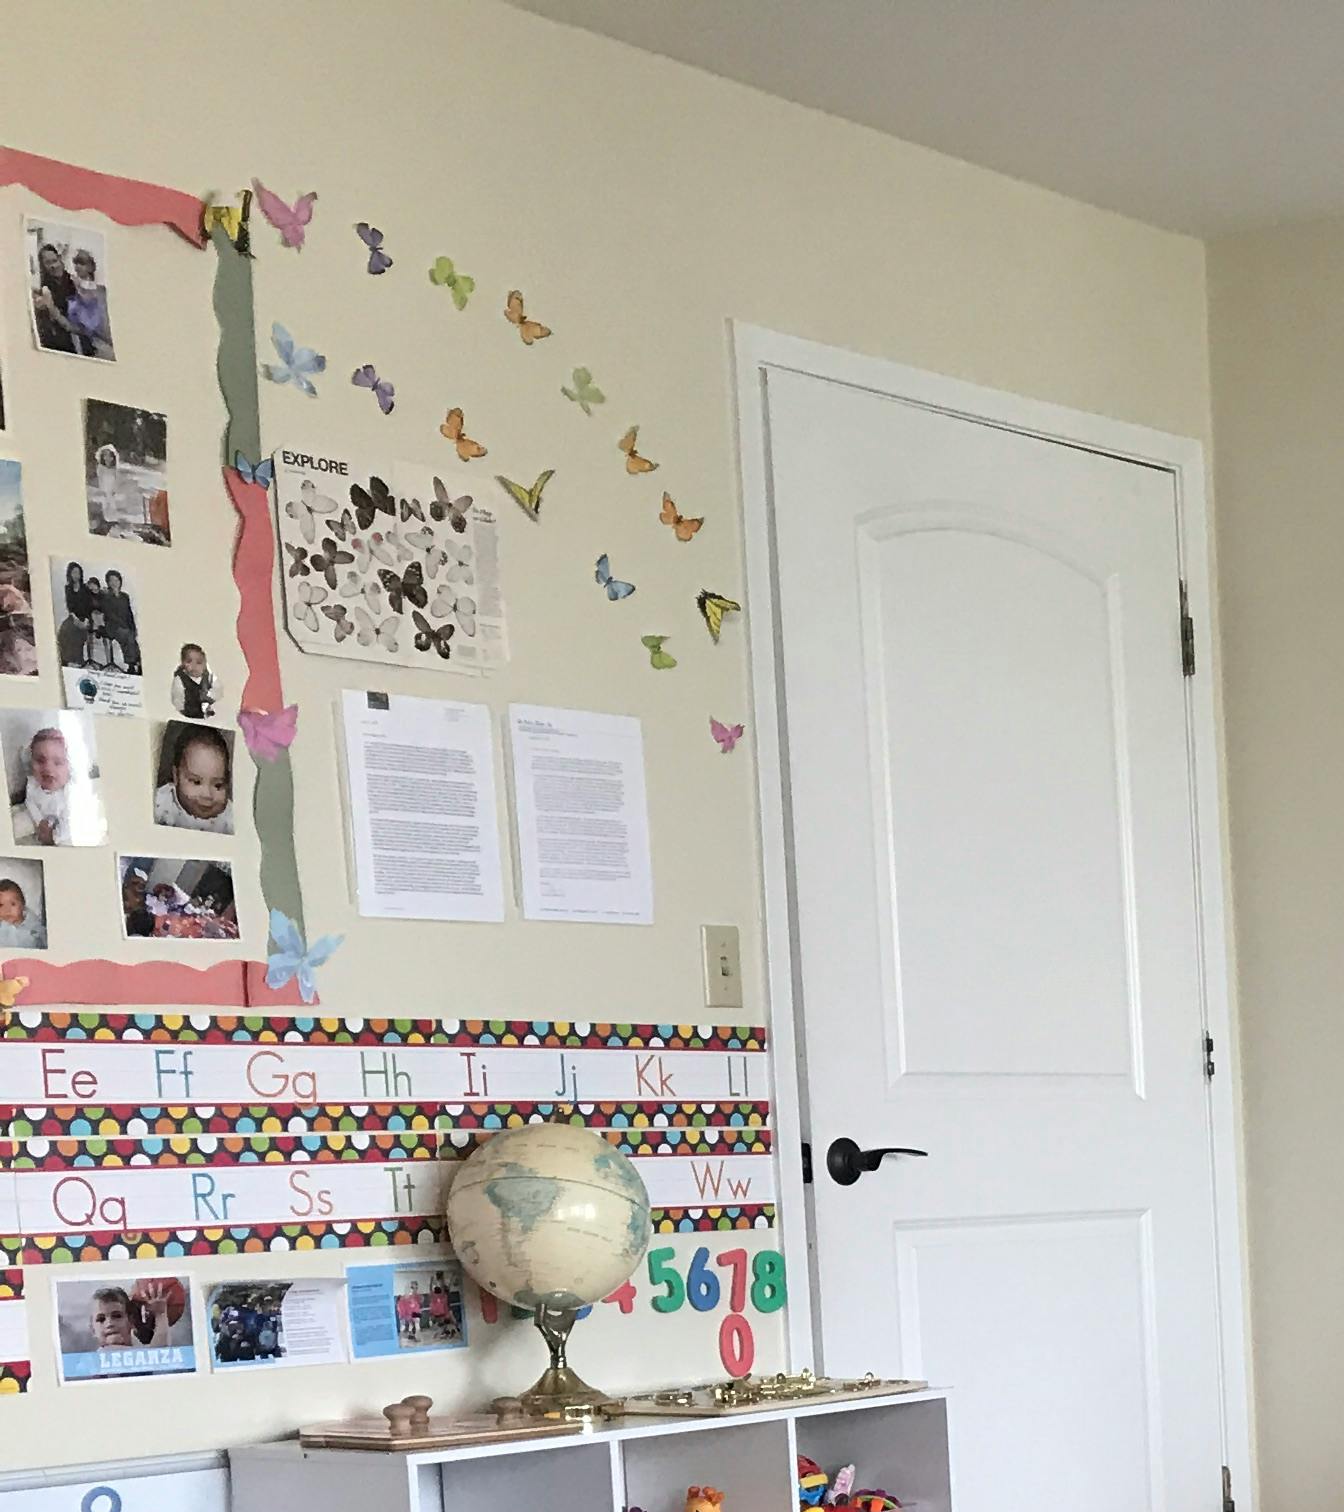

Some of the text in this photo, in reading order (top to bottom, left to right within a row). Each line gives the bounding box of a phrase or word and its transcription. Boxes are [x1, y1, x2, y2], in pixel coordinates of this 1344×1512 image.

[282, 450, 348, 476] EXPLORE
[42, 1048, 99, 1100] Ee
[154, 1049, 196, 1100] Ff
[246, 1050, 318, 1111] Gg
[360, 1051, 413, 1099] Hh
[459, 1053, 488, 1099] Ii
[555, 1053, 579, 1103] Jj
[634, 1054, 677, 1098] Kk
[52, 1159, 752, 1241] Qq Rr Ss Tt Ww
